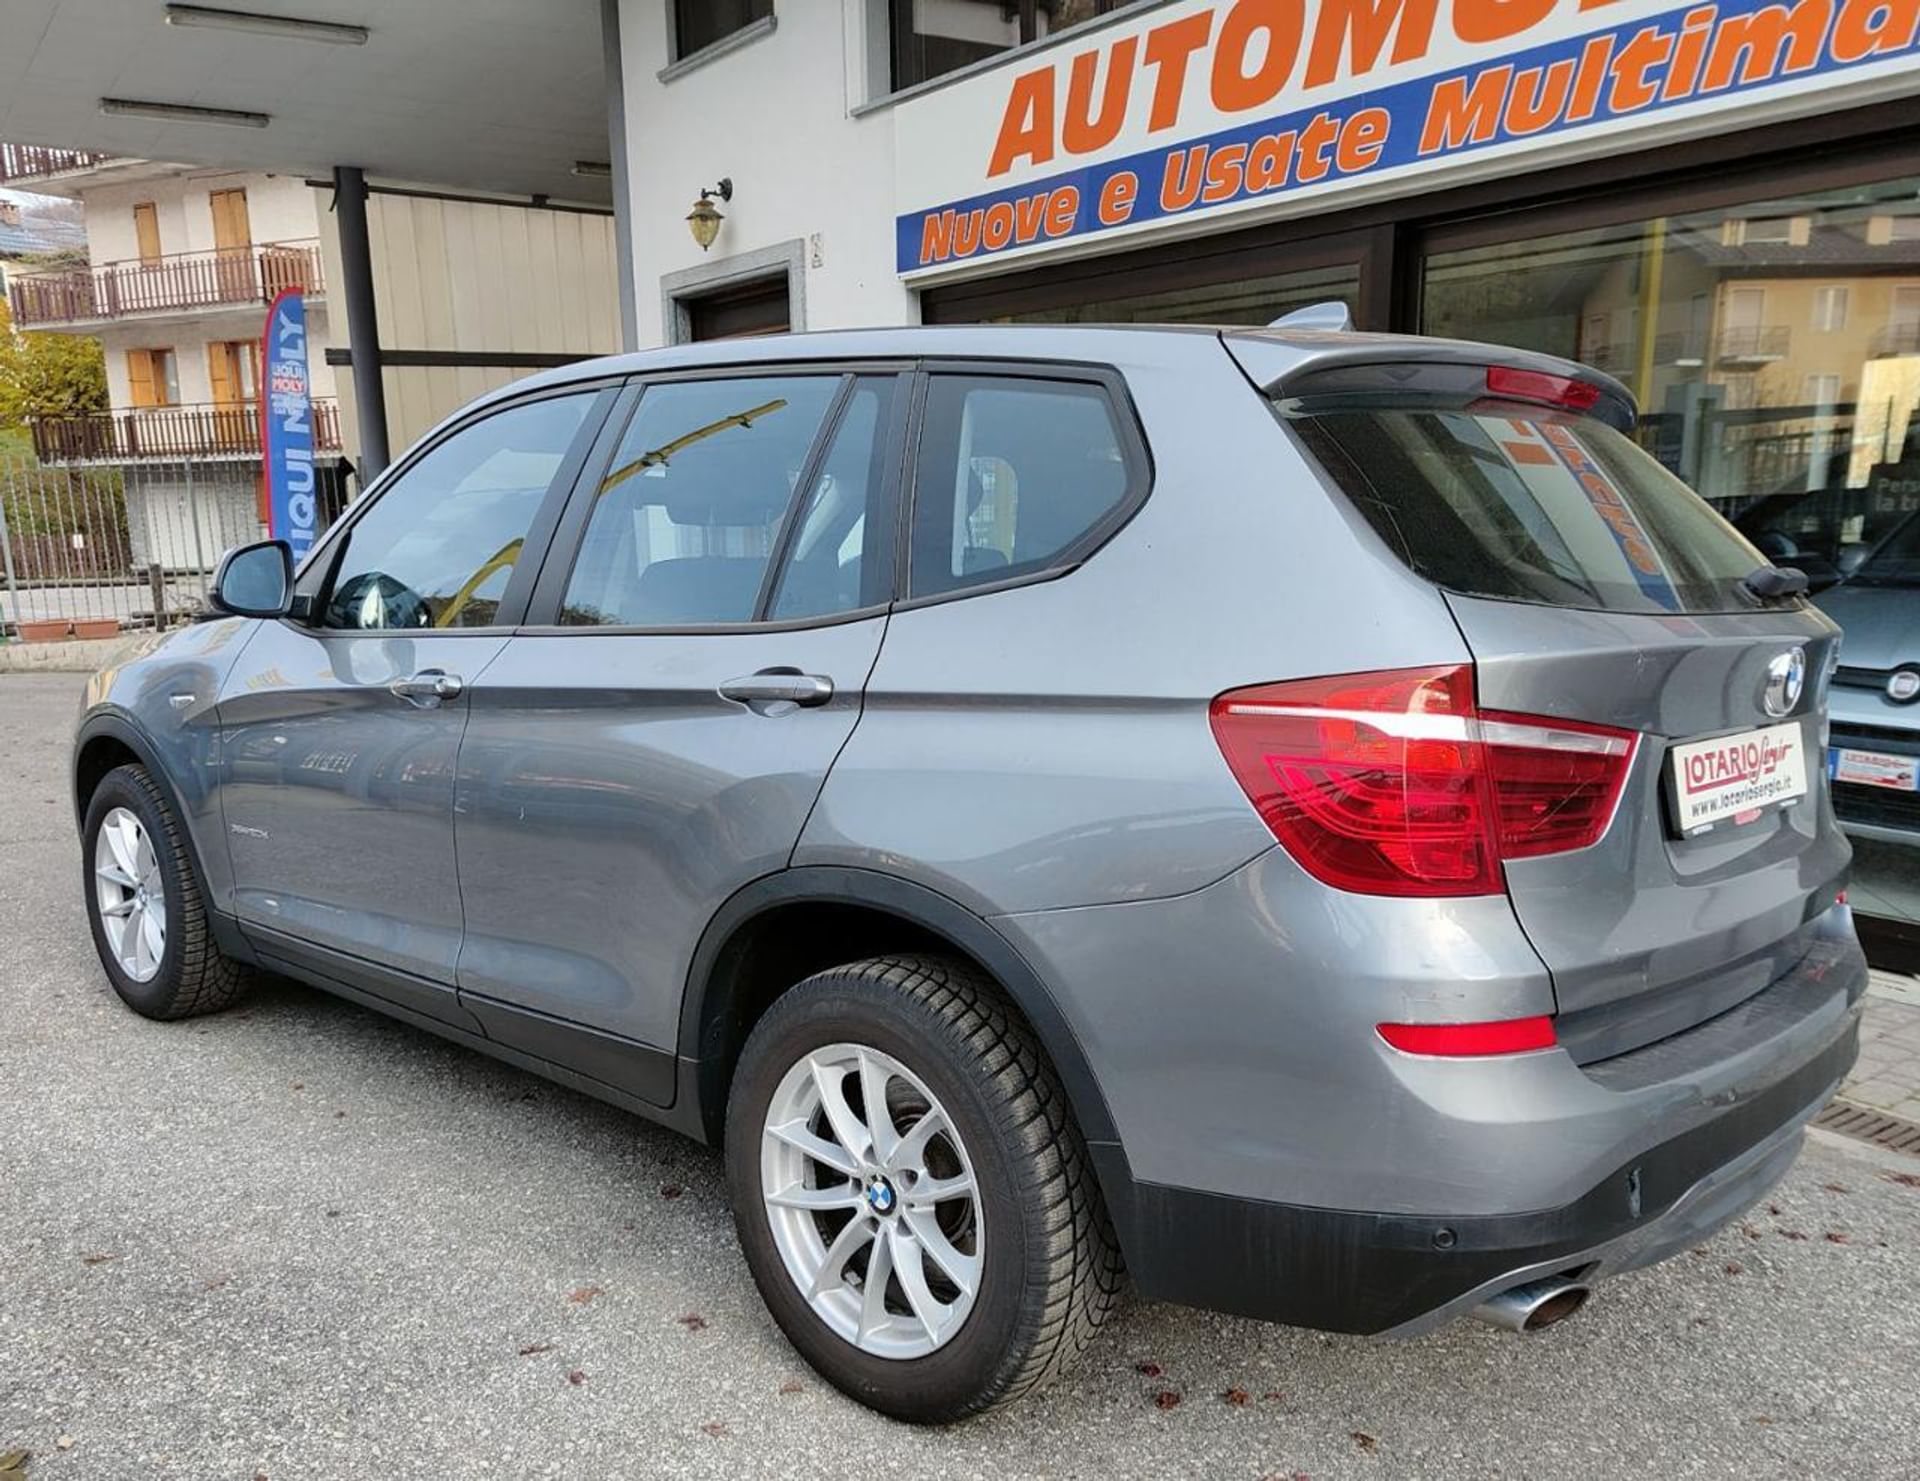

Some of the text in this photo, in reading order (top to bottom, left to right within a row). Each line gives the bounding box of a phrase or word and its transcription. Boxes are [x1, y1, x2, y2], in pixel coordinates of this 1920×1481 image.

[919, 185, 1080, 265] Nuove
[1098, 170, 1139, 225] e
[1160, 106, 1391, 213] Usate
[1684, 742, 1759, 795] LOTARIO
